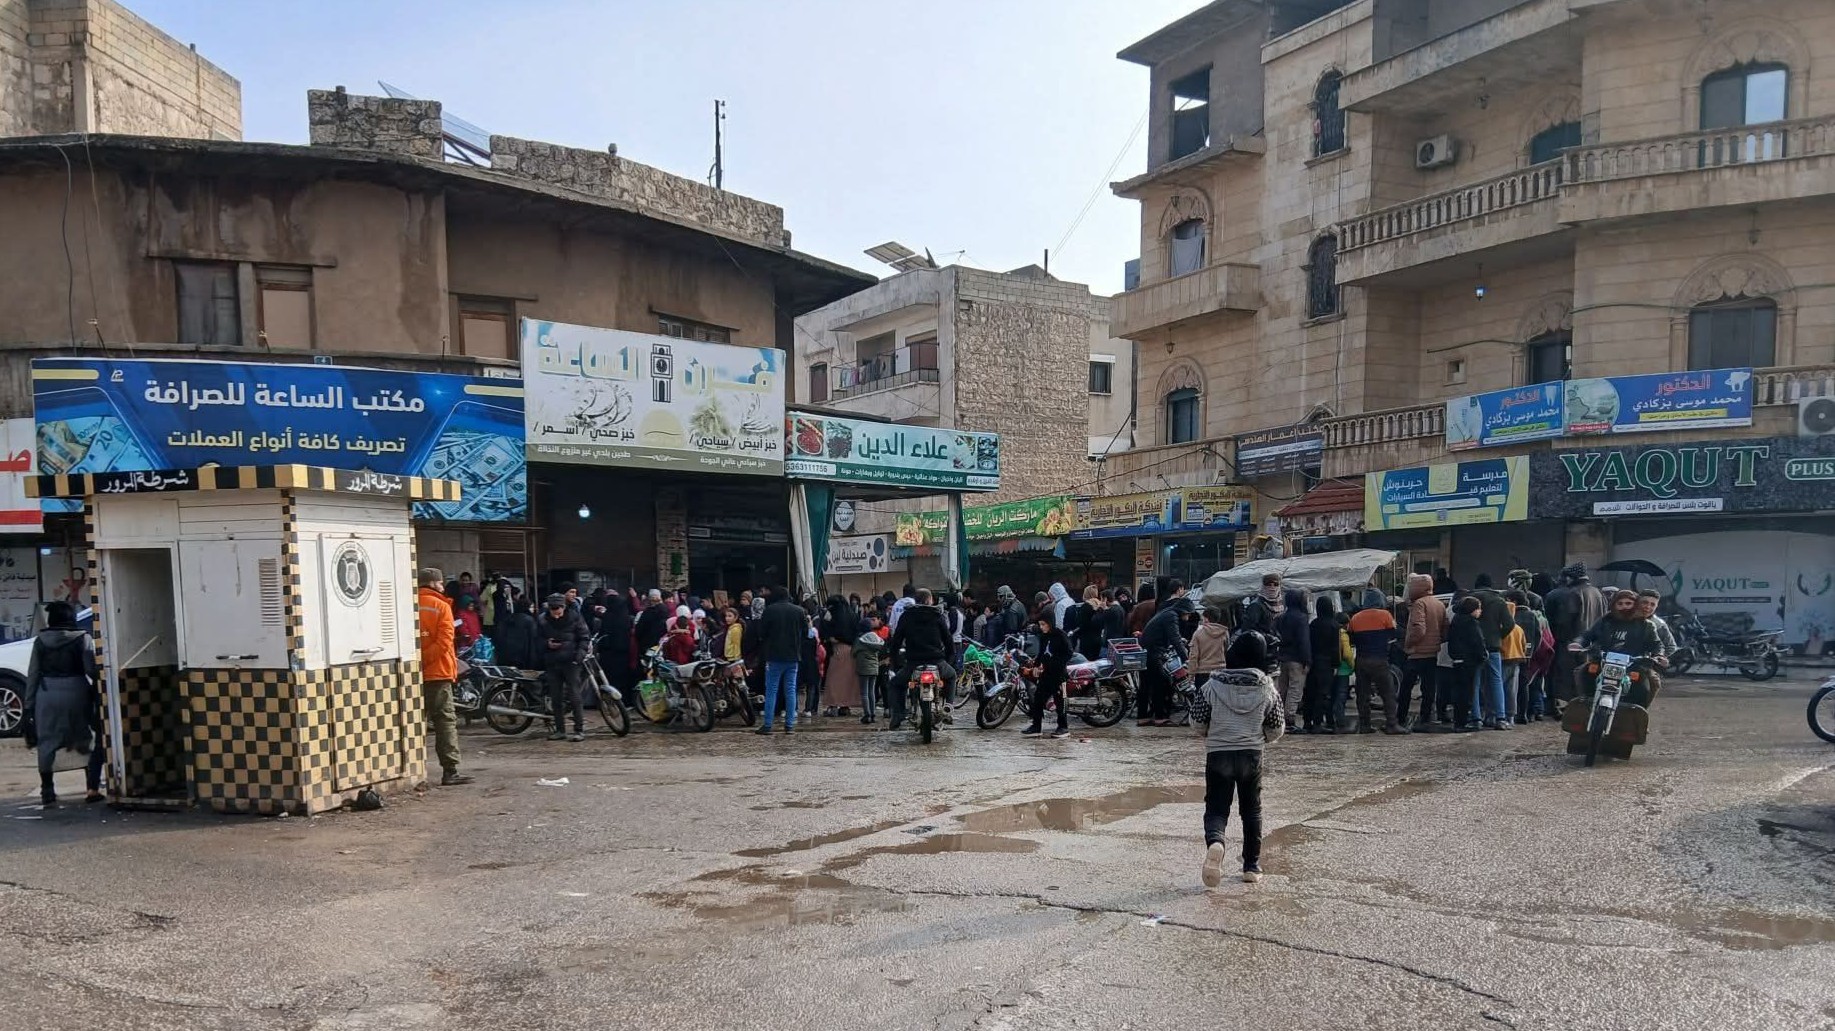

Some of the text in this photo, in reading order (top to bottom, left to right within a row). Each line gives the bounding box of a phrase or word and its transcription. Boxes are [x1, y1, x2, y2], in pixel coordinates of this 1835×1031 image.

[682, 358, 773, 396] فرن
[1655, 373, 1711, 396] الدكتور
[144, 379, 425, 416] مكتب الساعة للصرافة
[1502, 389, 1540, 408] الدكتور
[1676, 397, 1706, 409] موسى
[1710, 396, 1742, 405] محمد
[1513, 411, 1534, 424] موسى
[1537, 406, 1560, 417] محمد
[167, 426, 406, 455] تصريف كافة أنواع العملات
[589, 428, 619, 441] صحي
[621, 428, 635, 441] خبز
[696, 435, 729, 451] سياحي
[738, 434, 763, 451] أبيض
[765, 439, 777, 452] خبز
[858, 431, 948, 461] علاء الدين
[581, 447, 592, 457] غير
[611, 450, 631, 458] طحين
[1462, 469, 1508, 482] مدرسة
[1559, 445, 1770, 499] YAQUT
[1791, 462, 1835, 476] PLUS
[102, 470, 189, 493] شرطة المرور
[349, 472, 403, 492] شرطة المرور
[1479, 483, 1503, 494] لتعليم
[1387, 491, 1416, 502] السيارات
[1625, 502, 1651, 511] الحوالات
[1657, 501, 1681, 511] للصرافة
[1681, 502, 1696, 510] بلس
[1697, 500, 1717, 510] ياقوت
[986, 510, 1007, 528] الريان
[1009, 508, 1037, 523] ماركت
[842, 548, 867, 563] صيدلية
[1692, 578, 1751, 592] YAQUT
